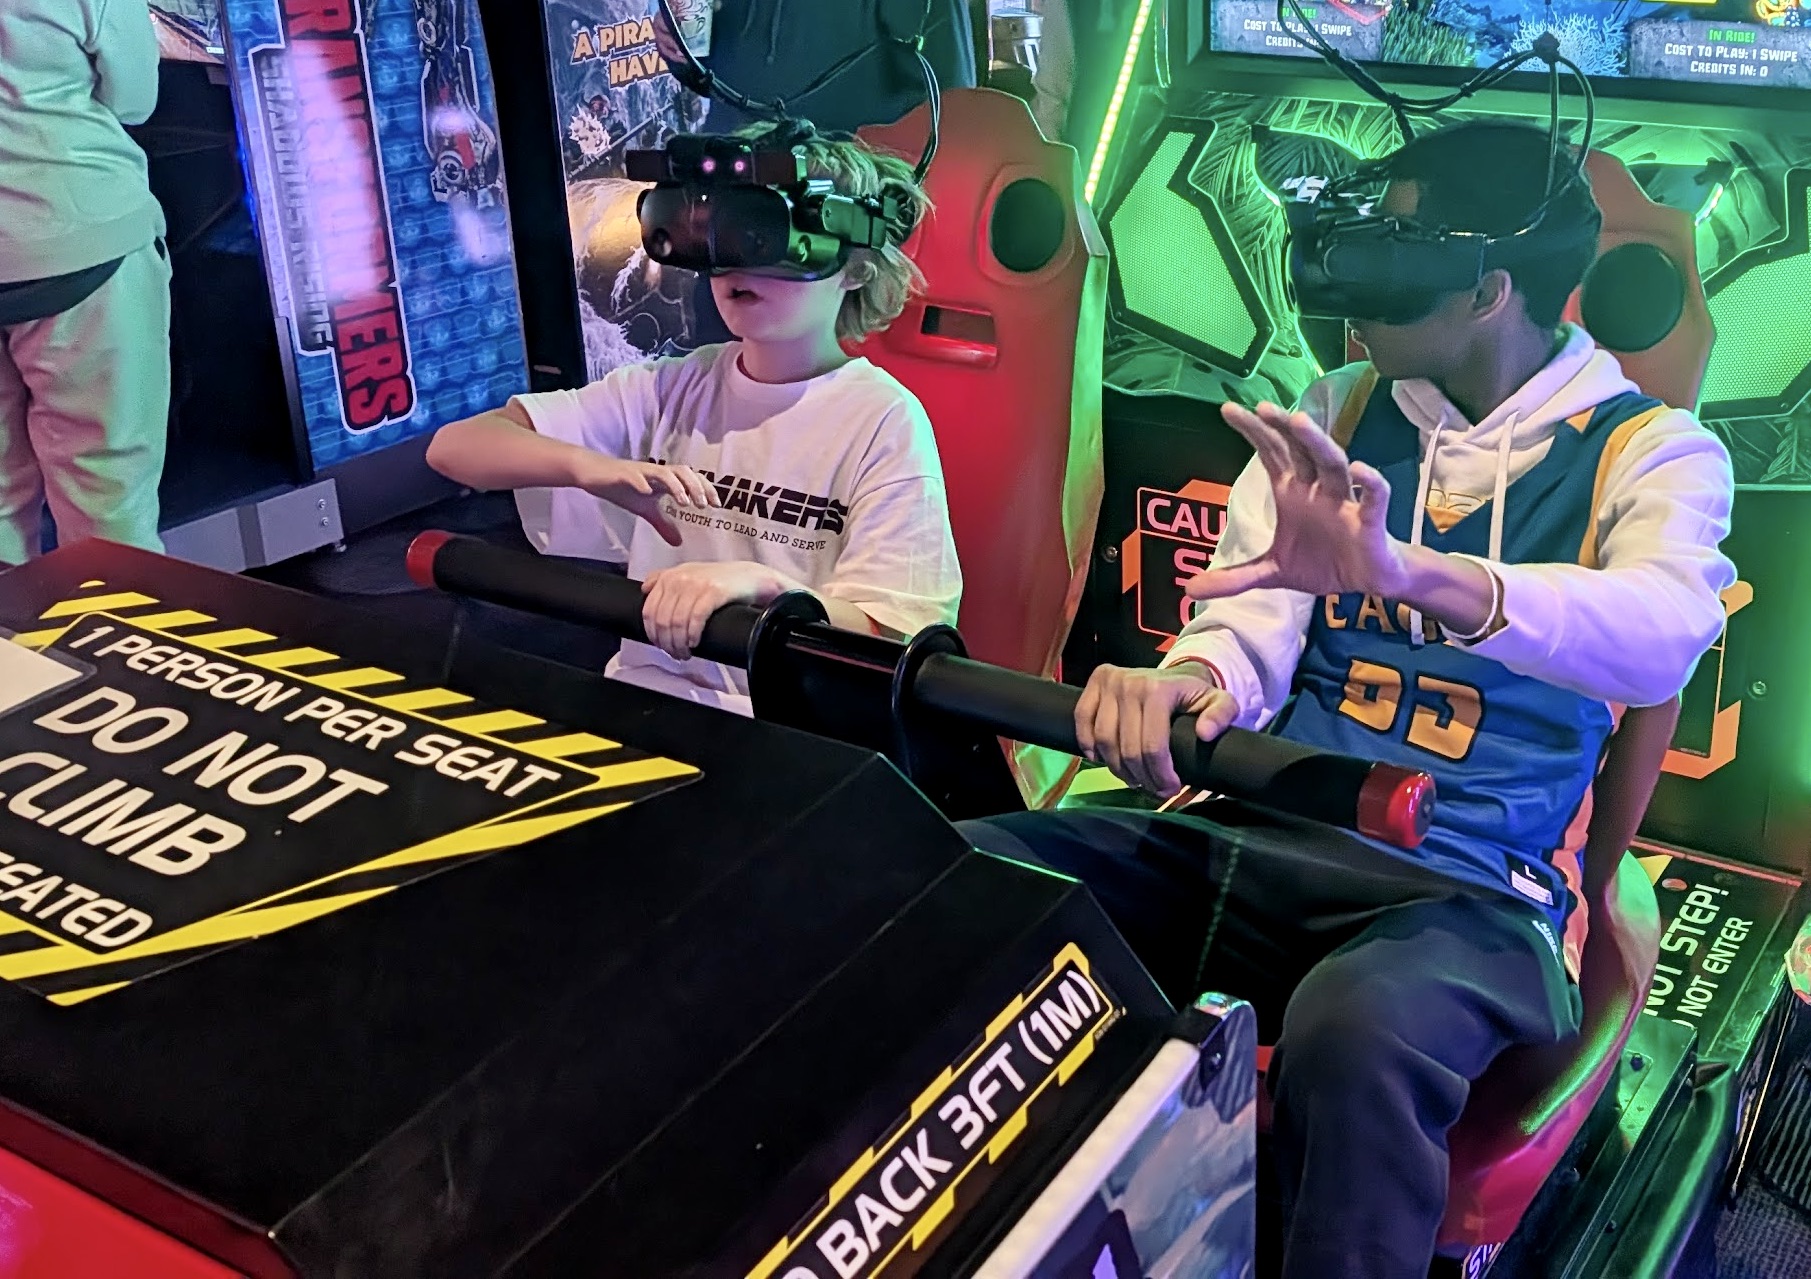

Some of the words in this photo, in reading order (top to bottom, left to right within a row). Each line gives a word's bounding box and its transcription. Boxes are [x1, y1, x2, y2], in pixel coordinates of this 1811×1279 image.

[572, 31, 596, 59] A
[599, 16, 657, 54] PIRA
[1243, 19, 1267, 31] COST
[1321, 23, 1352, 36] SWIPE
[1665, 43, 1693, 56] COST
[1697, 45, 1712, 57] TO
[1715, 46, 1748, 60] PLAY:
[1760, 48, 1798, 62] SWIPE
[1709, 29, 1722, 41] IN
[1725, 30, 1755, 43] RIDE!
[1690, 61, 1737, 75] CREDITS
[1740, 64, 1757, 76] IN:
[648, 456, 849, 536] MAKERS
[678, 510, 712, 527] YOUTH
[715, 519, 732, 531] TO
[734, 523, 758, 537] LEAD
[760, 531, 789, 545] AND
[791, 538, 826, 551] SERVE
[1146, 498, 1228, 541] CAU
[69, 625, 107, 651] 1
[97, 634, 300, 713] PERSON
[285, 698, 407, 749] PER
[395, 733, 562, 797] SEAT
[33, 686, 188, 753] DO
[163, 732, 389, 823] NOT
[0, 752, 247, 876] CLIMB
[0, 852, 153, 948] EATED
[1659, 883, 1730, 957] STEP!
[1676, 974, 1719, 1018] NOT
[1701, 916, 1754, 975] ENTER
[815, 1127, 953, 1279] BACK
[937, 1042, 1026, 1151] 3FT
[1018, 970, 1102, 1066] (1M)
